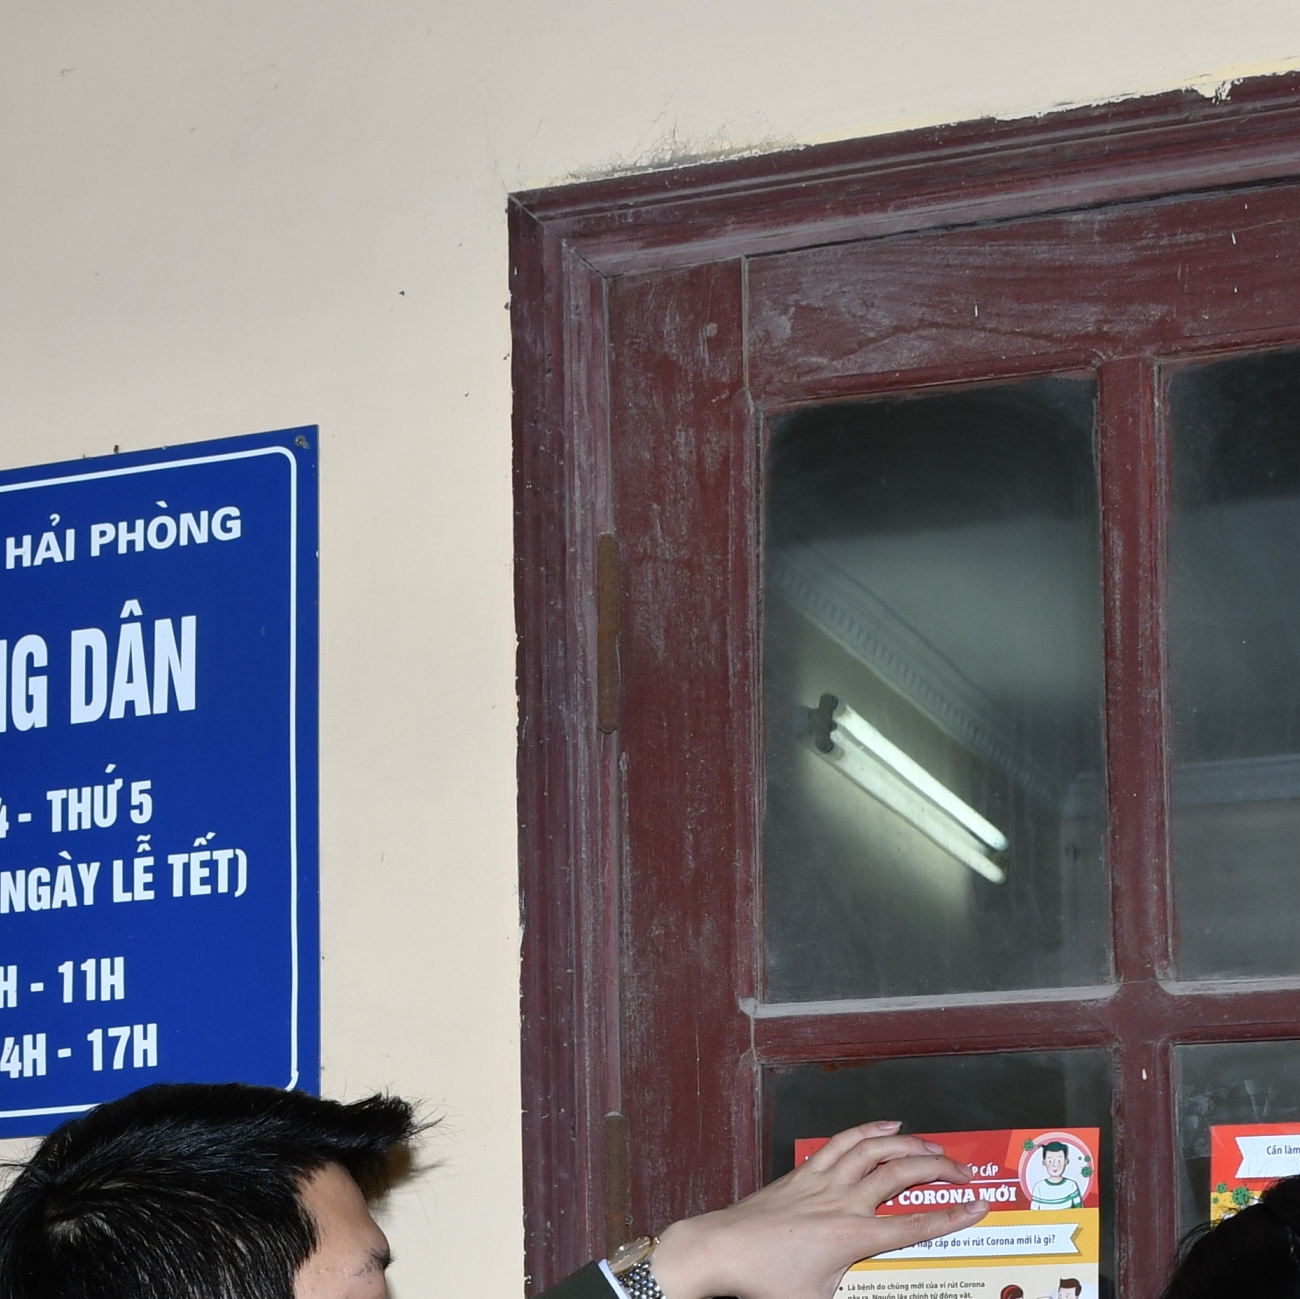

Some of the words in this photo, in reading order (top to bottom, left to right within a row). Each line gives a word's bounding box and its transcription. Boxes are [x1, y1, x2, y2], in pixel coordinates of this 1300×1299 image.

[6, 514, 75, 569] HẢI
[91, 501, 241, 556] PHÒNG
[71, 599, 196, 724] DÂN
[47, 764, 123, 832] THỨ
[130, 780, 152, 823] 5
[0, 851, 100, 913] NGÀY
[113, 835, 154, 902] LỄ
[168, 832, 247, 897] TẾT)
[58, 957, 124, 1003] 11H
[87, 1023, 157, 1071] 17H
[979, 1162, 999, 1176] CẤP
[1266, 1143, 1282, 1155] Cần
[1284, 1144, 1300, 1155] làm
[898, 1188, 976, 1206] CORONA
[979, 1185, 1017, 1202] MỚI
[951, 1237, 961, 1247] do
[963, 1237, 970, 1246] vi
[972, 1237, 984, 1246] rút
[986, 1236, 1015, 1246] Corona
[1016, 1235, 1032, 1245] mới
[1034, 1235, 1041, 1244] là
[1044, 1234, 1055, 1246] gì?
[857, 1283, 875, 1292] bệnh
[910, 1281, 924, 1289] mới
[959, 1280, 985, 1289] Corona
